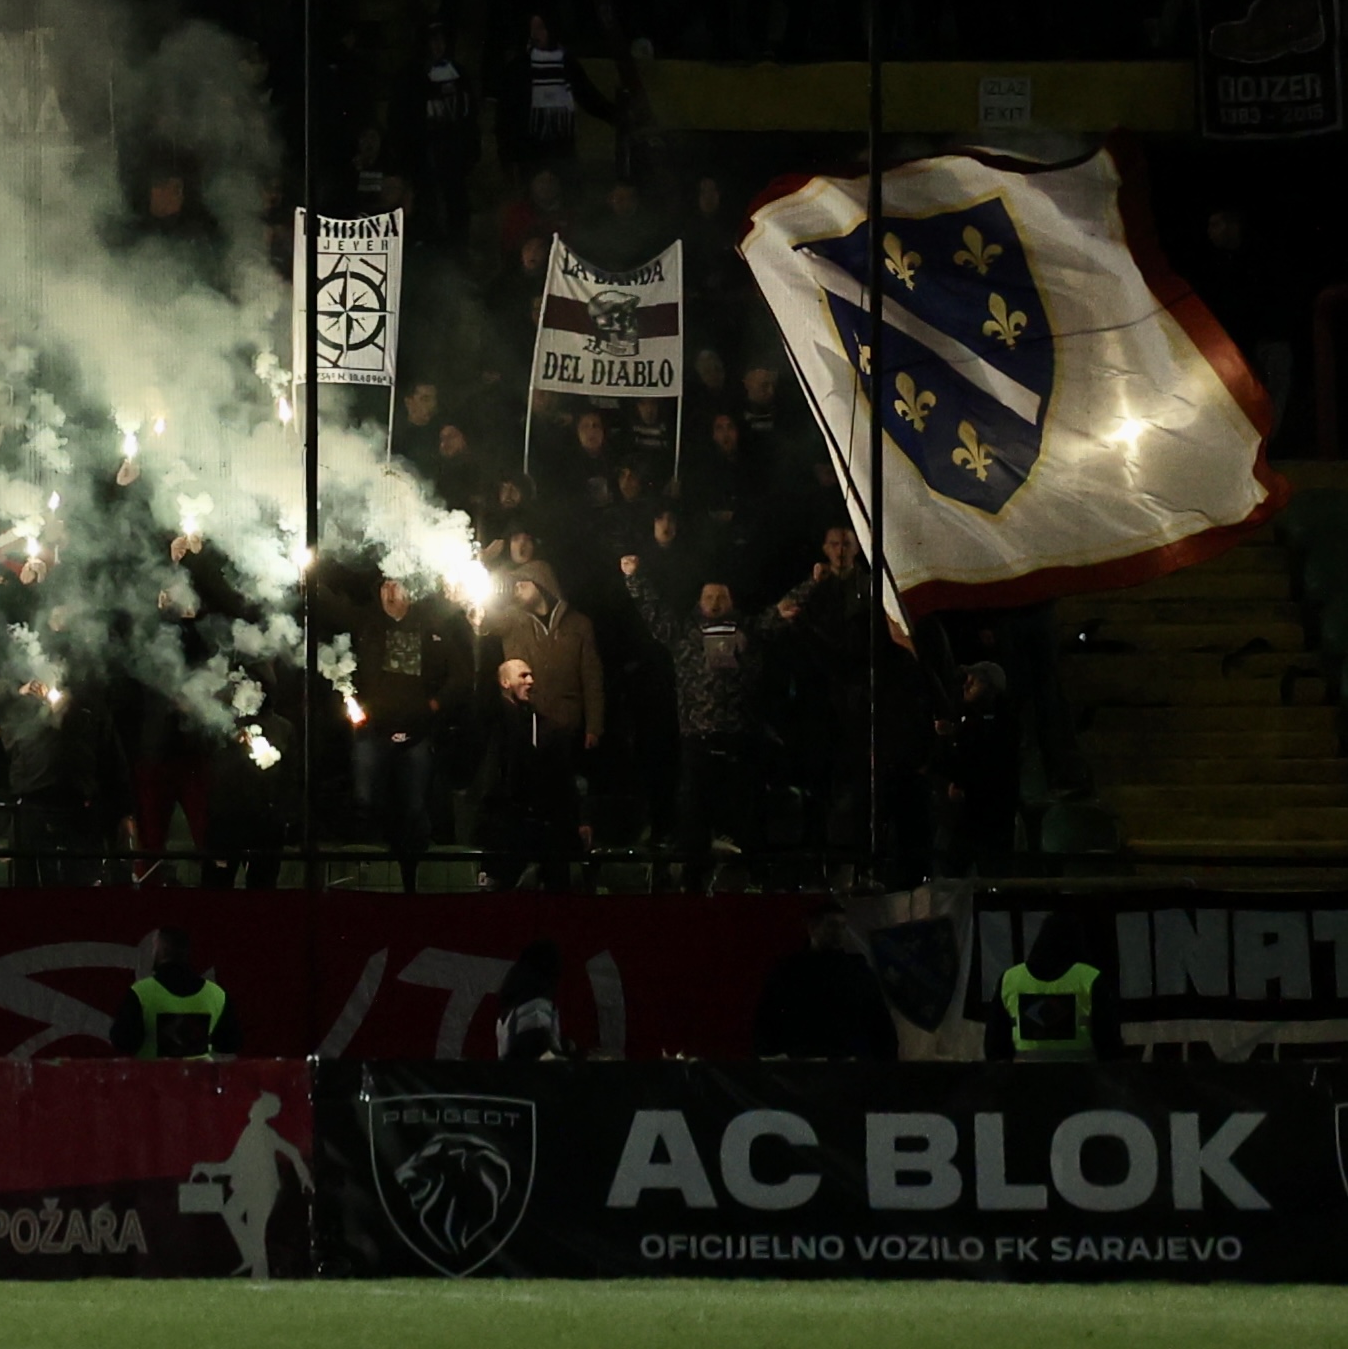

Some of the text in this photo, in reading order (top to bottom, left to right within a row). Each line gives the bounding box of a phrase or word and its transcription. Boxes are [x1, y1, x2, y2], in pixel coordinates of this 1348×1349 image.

[301, 212, 400, 240] RIBINA
[321, 239, 389, 251] JEVER
[542, 351, 674, 388] DEL DIABLO
[382, 1108, 521, 1128] PEUGEOT
[605, 1109, 1274, 1213] AC BLOK
[640, 1233, 1244, 1265] OFICIJELNO VOZILO FK SARAJEVO
